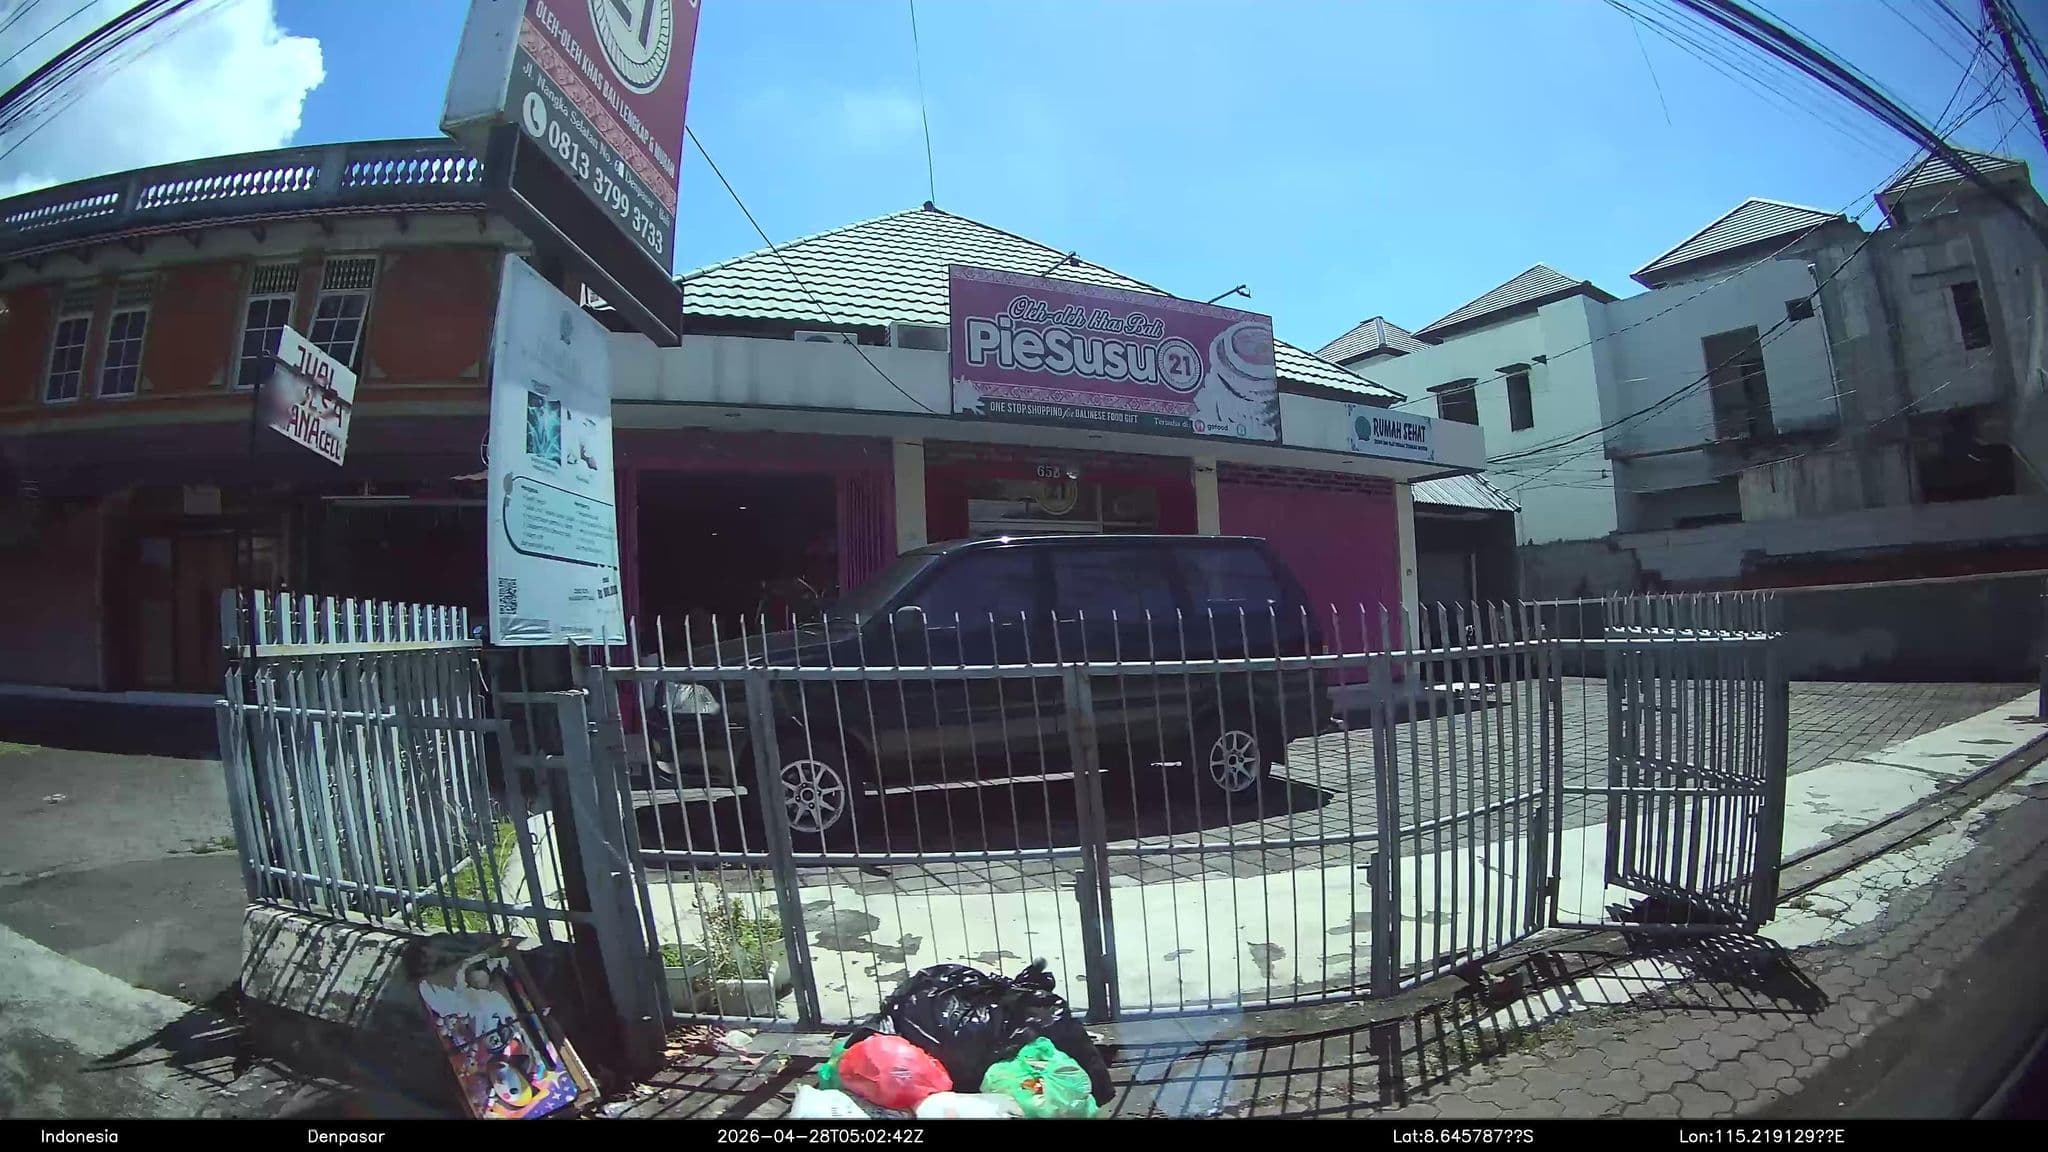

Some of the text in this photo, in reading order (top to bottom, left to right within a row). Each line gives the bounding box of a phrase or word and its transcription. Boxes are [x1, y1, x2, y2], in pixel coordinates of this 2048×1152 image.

[536, 1, 582, 64] OLEH-OLEH
[581, 54, 604, 90] KHAS
[602, 80, 620, 111] BALI
[537, 74, 569, 116] Nangka
[549, 120, 663, 253] 0813 3799 3733
[1009, 296, 1165, 338] Oleh-oleh khas Bali
[294, 344, 334, 391] JUAL
[967, 315, 1192, 384] PieSusu 21
[990, 401, 1006, 412] ONE
[1007, 403, 1027, 414] STOP
[1075, 408, 1106, 421] BALINESE
[1107, 411, 1124, 422] FOOD
[1373, 418, 1426, 443] RUMAH SEHAT
